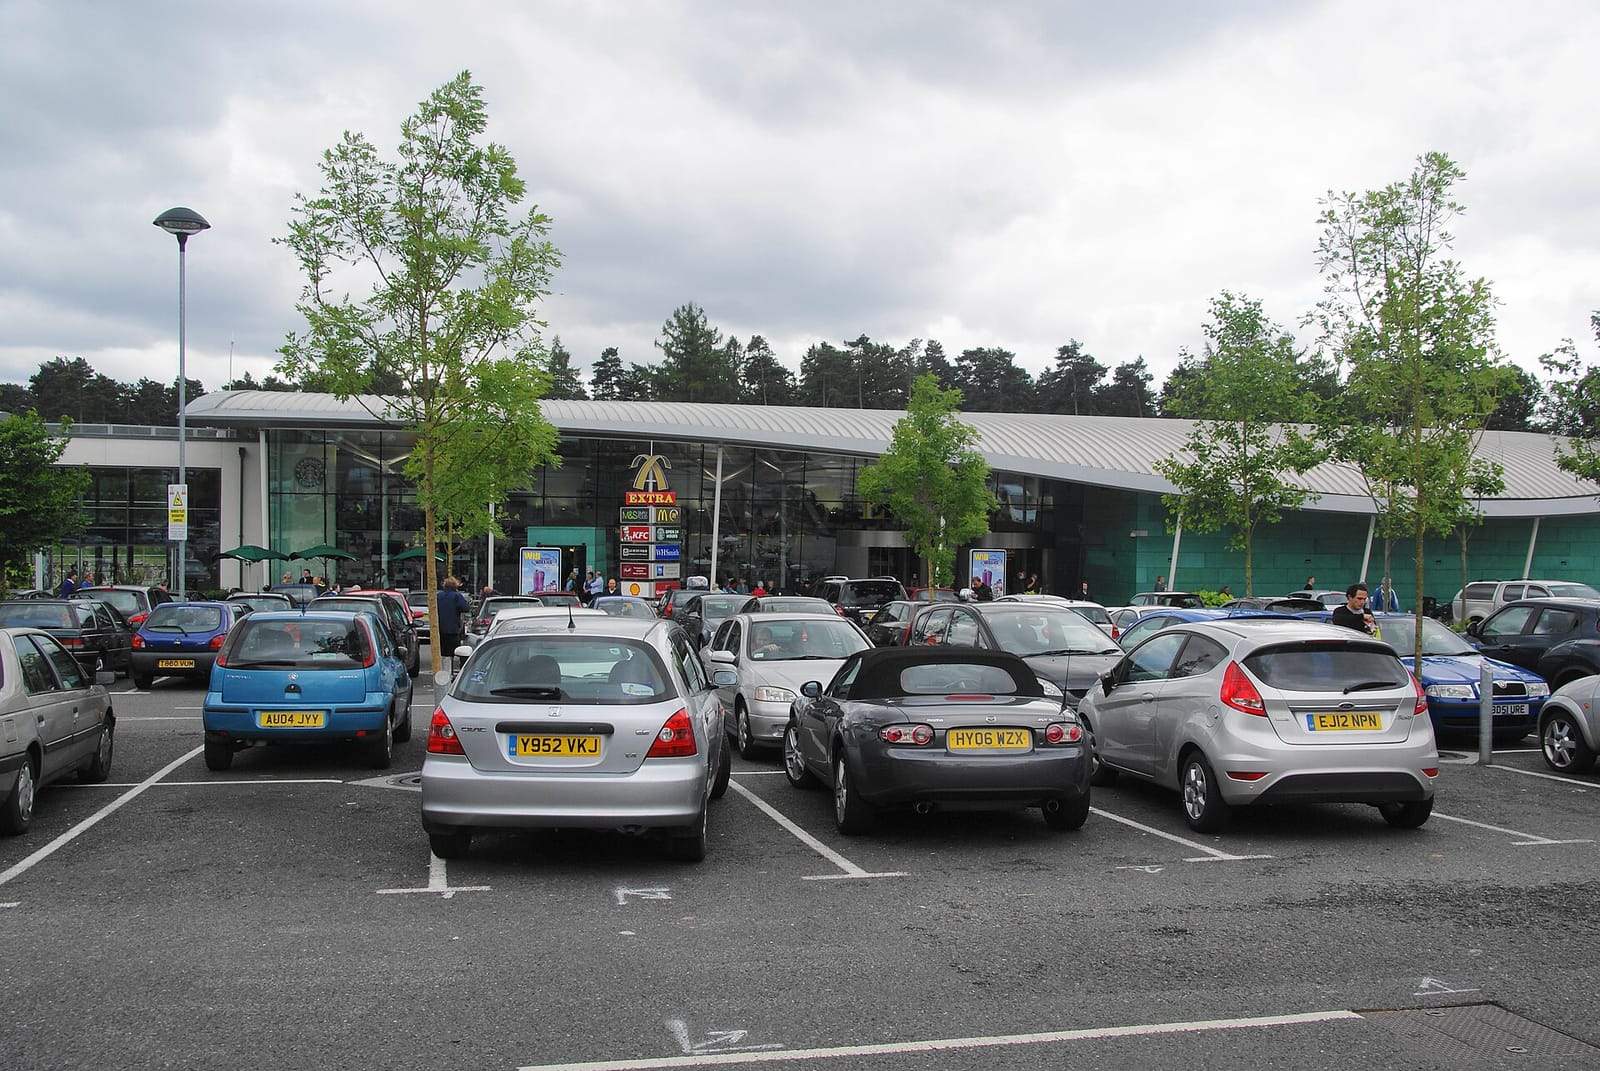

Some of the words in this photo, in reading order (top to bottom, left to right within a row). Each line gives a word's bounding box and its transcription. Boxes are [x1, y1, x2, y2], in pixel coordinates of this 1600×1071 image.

[629, 493, 674, 503] EXTRA
[622, 510, 638, 520] M&S
[632, 531, 649, 540] KFC
[656, 548, 680, 556] WHSmith
[1510, 705, 1525, 713] URE
[266, 714, 294, 724] AU04
[298, 714, 319, 724] JYY
[1319, 715, 1348, 728] EJ12
[1351, 714, 1377, 727] NPN
[956, 732, 993, 745] HY06
[996, 732, 1024, 745] WZX
[520, 738, 562, 753] Y952
[567, 738, 598, 753] VKJ
